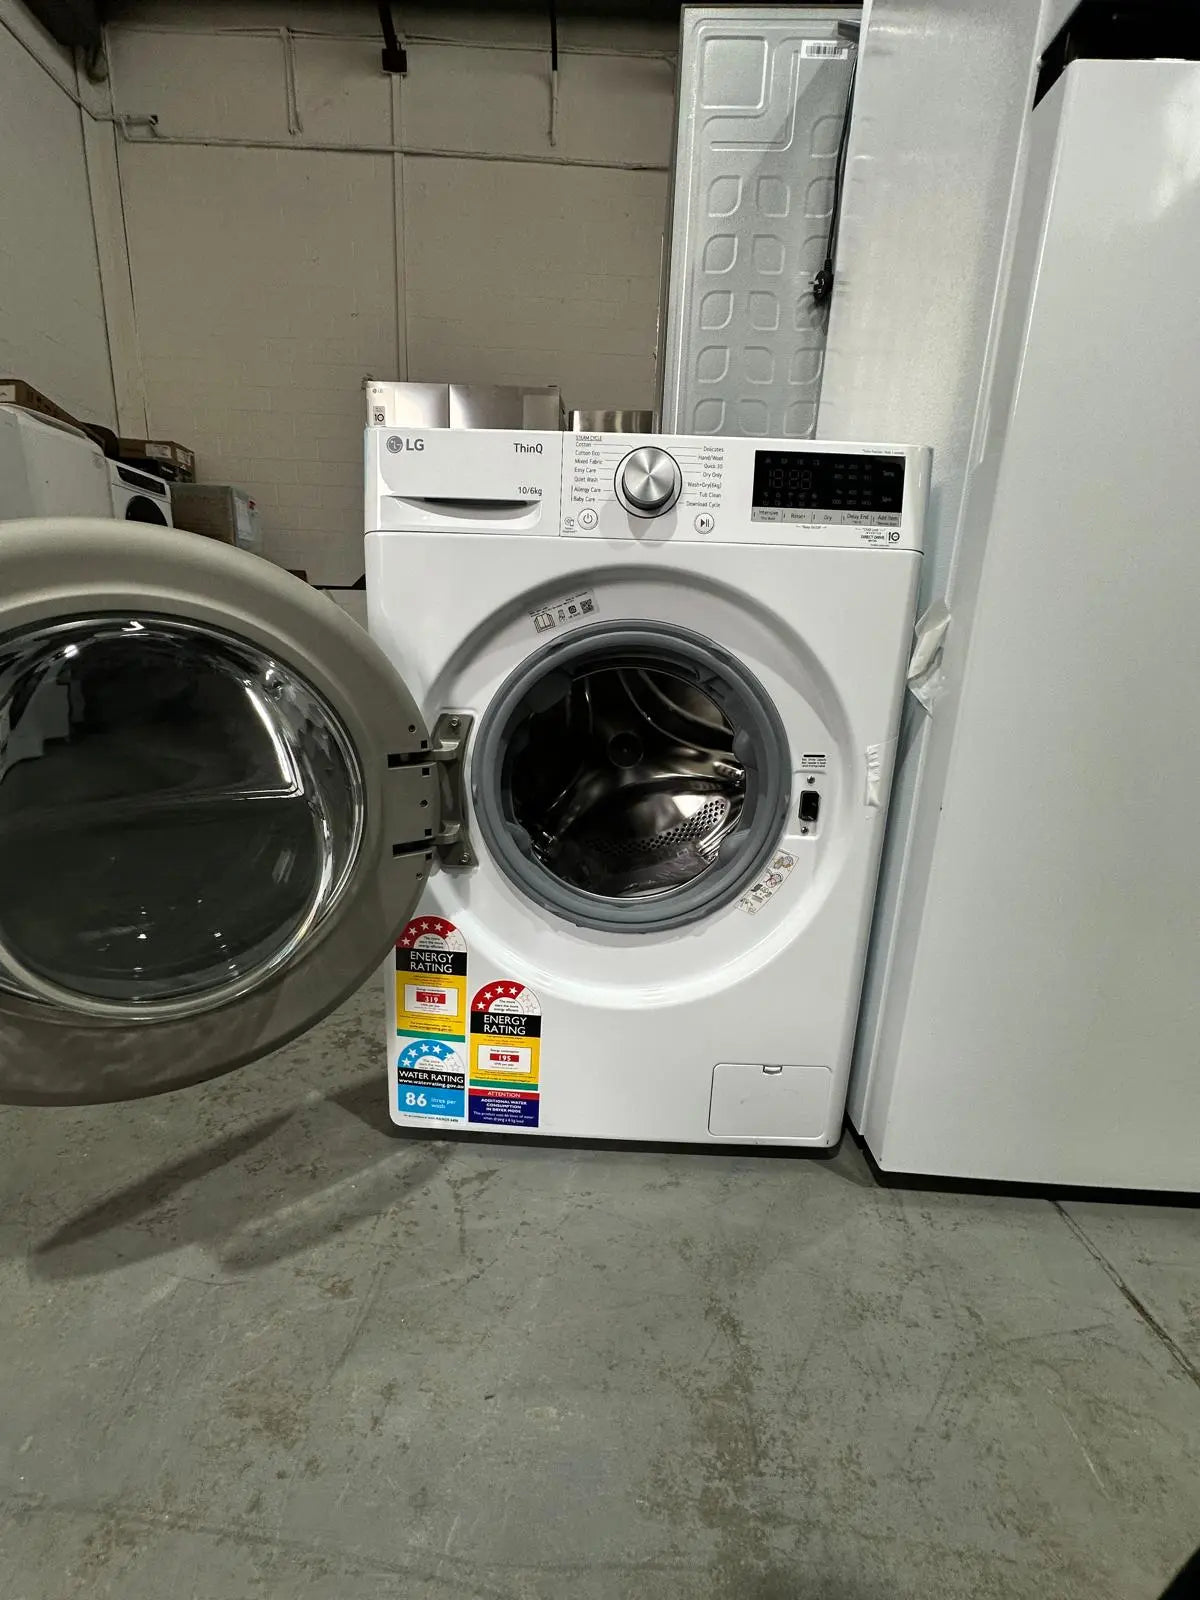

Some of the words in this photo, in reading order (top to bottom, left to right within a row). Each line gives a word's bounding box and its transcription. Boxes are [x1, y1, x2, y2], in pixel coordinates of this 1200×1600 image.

[406, 438, 424, 451] LG
[513, 443, 543, 454] ThinQ
[518, 487, 542, 496] 10/6kg
[410, 951, 454, 963] ENERGY
[410, 962, 452, 973] RATING
[484, 1015, 527, 1025] ENERGY
[484, 1024, 526, 1035] RATING
[399, 1070, 428, 1080] WATER
[431, 1074, 464, 1083] RATING
[399, 1079, 464, 1088] www.waterrating.gov.au
[406, 1092, 427, 1107] 86
